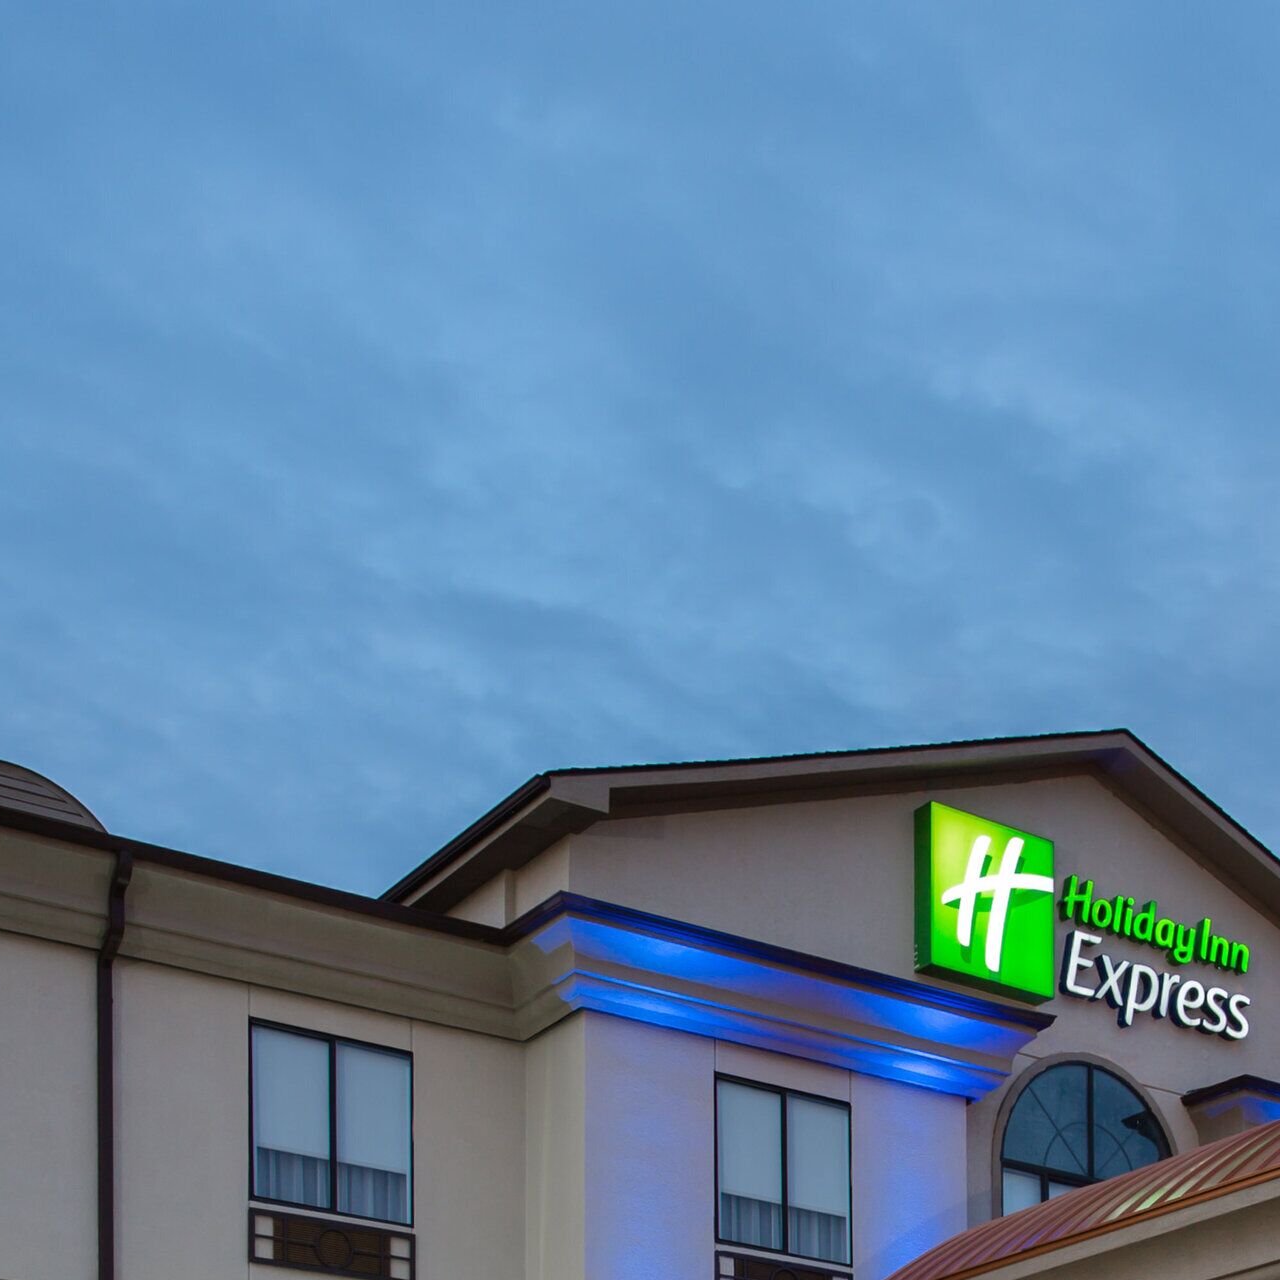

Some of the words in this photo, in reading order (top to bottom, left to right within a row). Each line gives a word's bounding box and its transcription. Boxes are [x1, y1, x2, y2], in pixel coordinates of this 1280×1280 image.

[1062, 874, 1196, 965] Holiday
[1197, 917, 1251, 974] Inn
[1063, 929, 1252, 1041] Express
